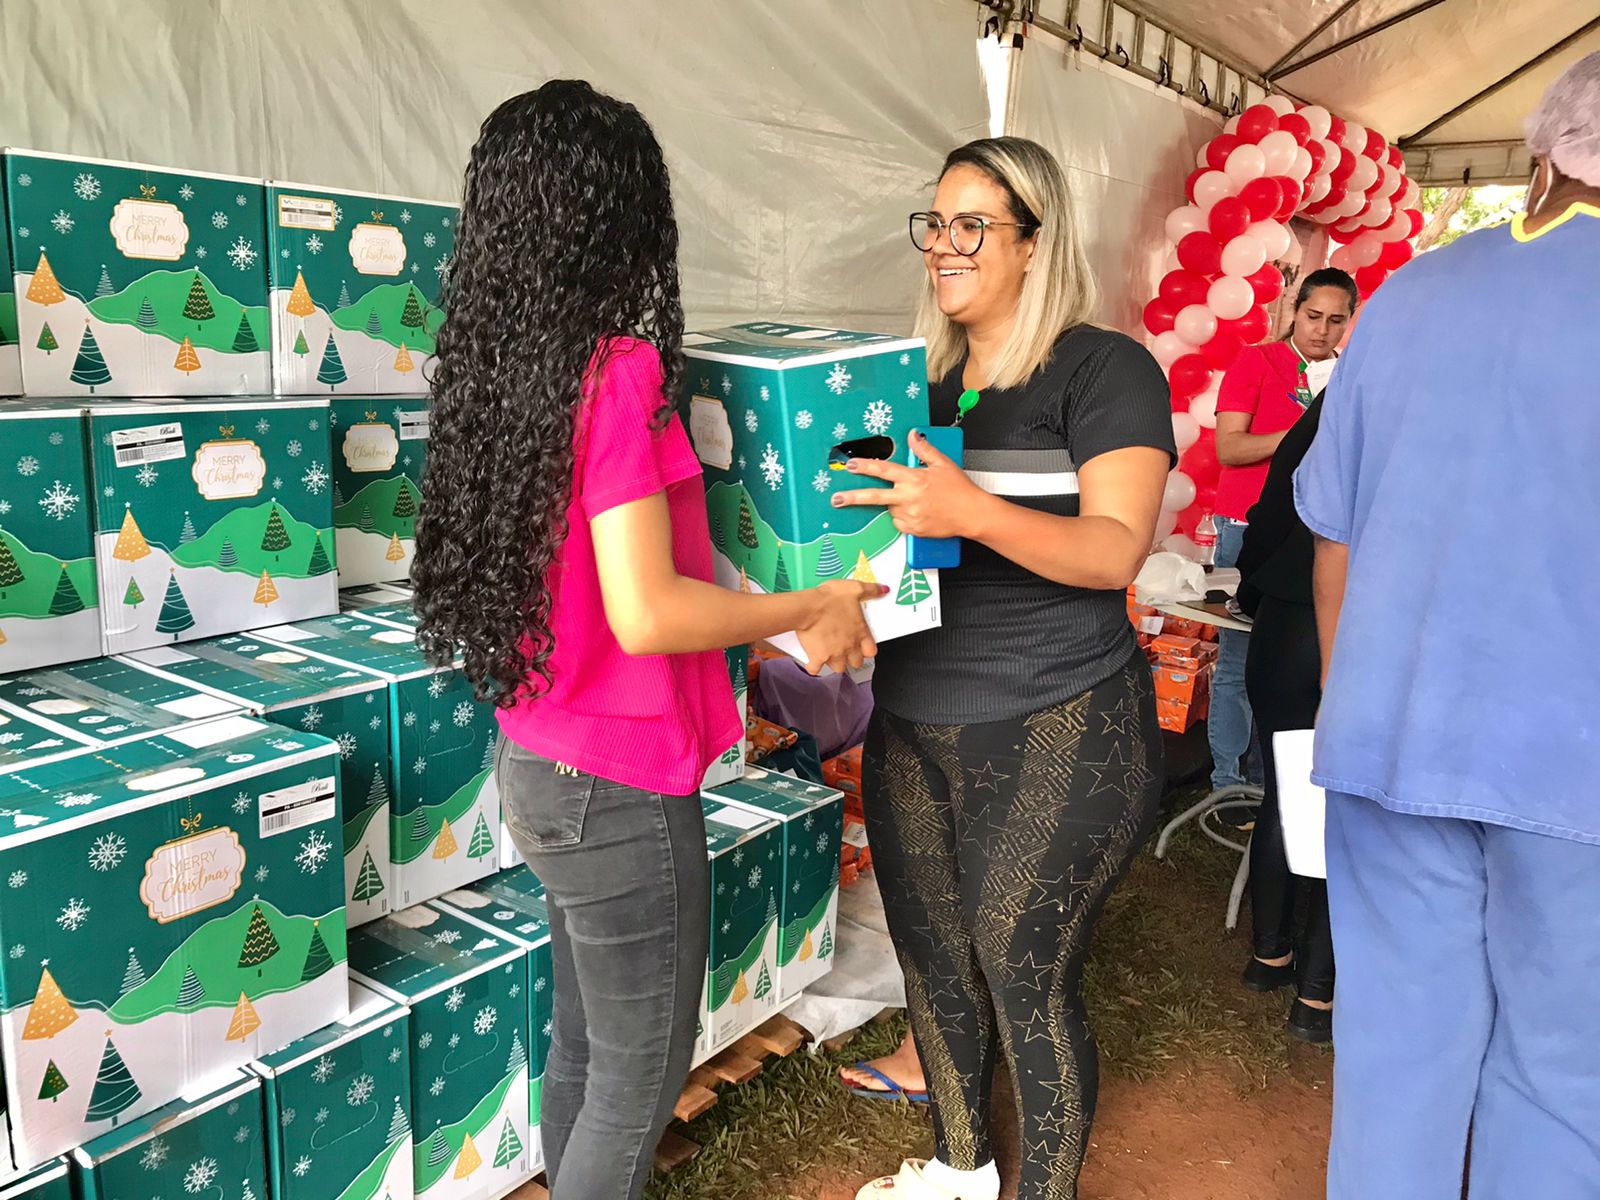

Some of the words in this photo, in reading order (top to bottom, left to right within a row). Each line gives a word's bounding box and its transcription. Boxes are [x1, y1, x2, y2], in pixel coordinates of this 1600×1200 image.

[132, 213, 168, 227] MERRY
[125, 224, 178, 246] Christmas
[213, 455, 246, 467] MERRY
[205, 464, 256, 486] Christmas
[170, 848, 217, 874] MERRY
[160, 864, 230, 902] Christmas
